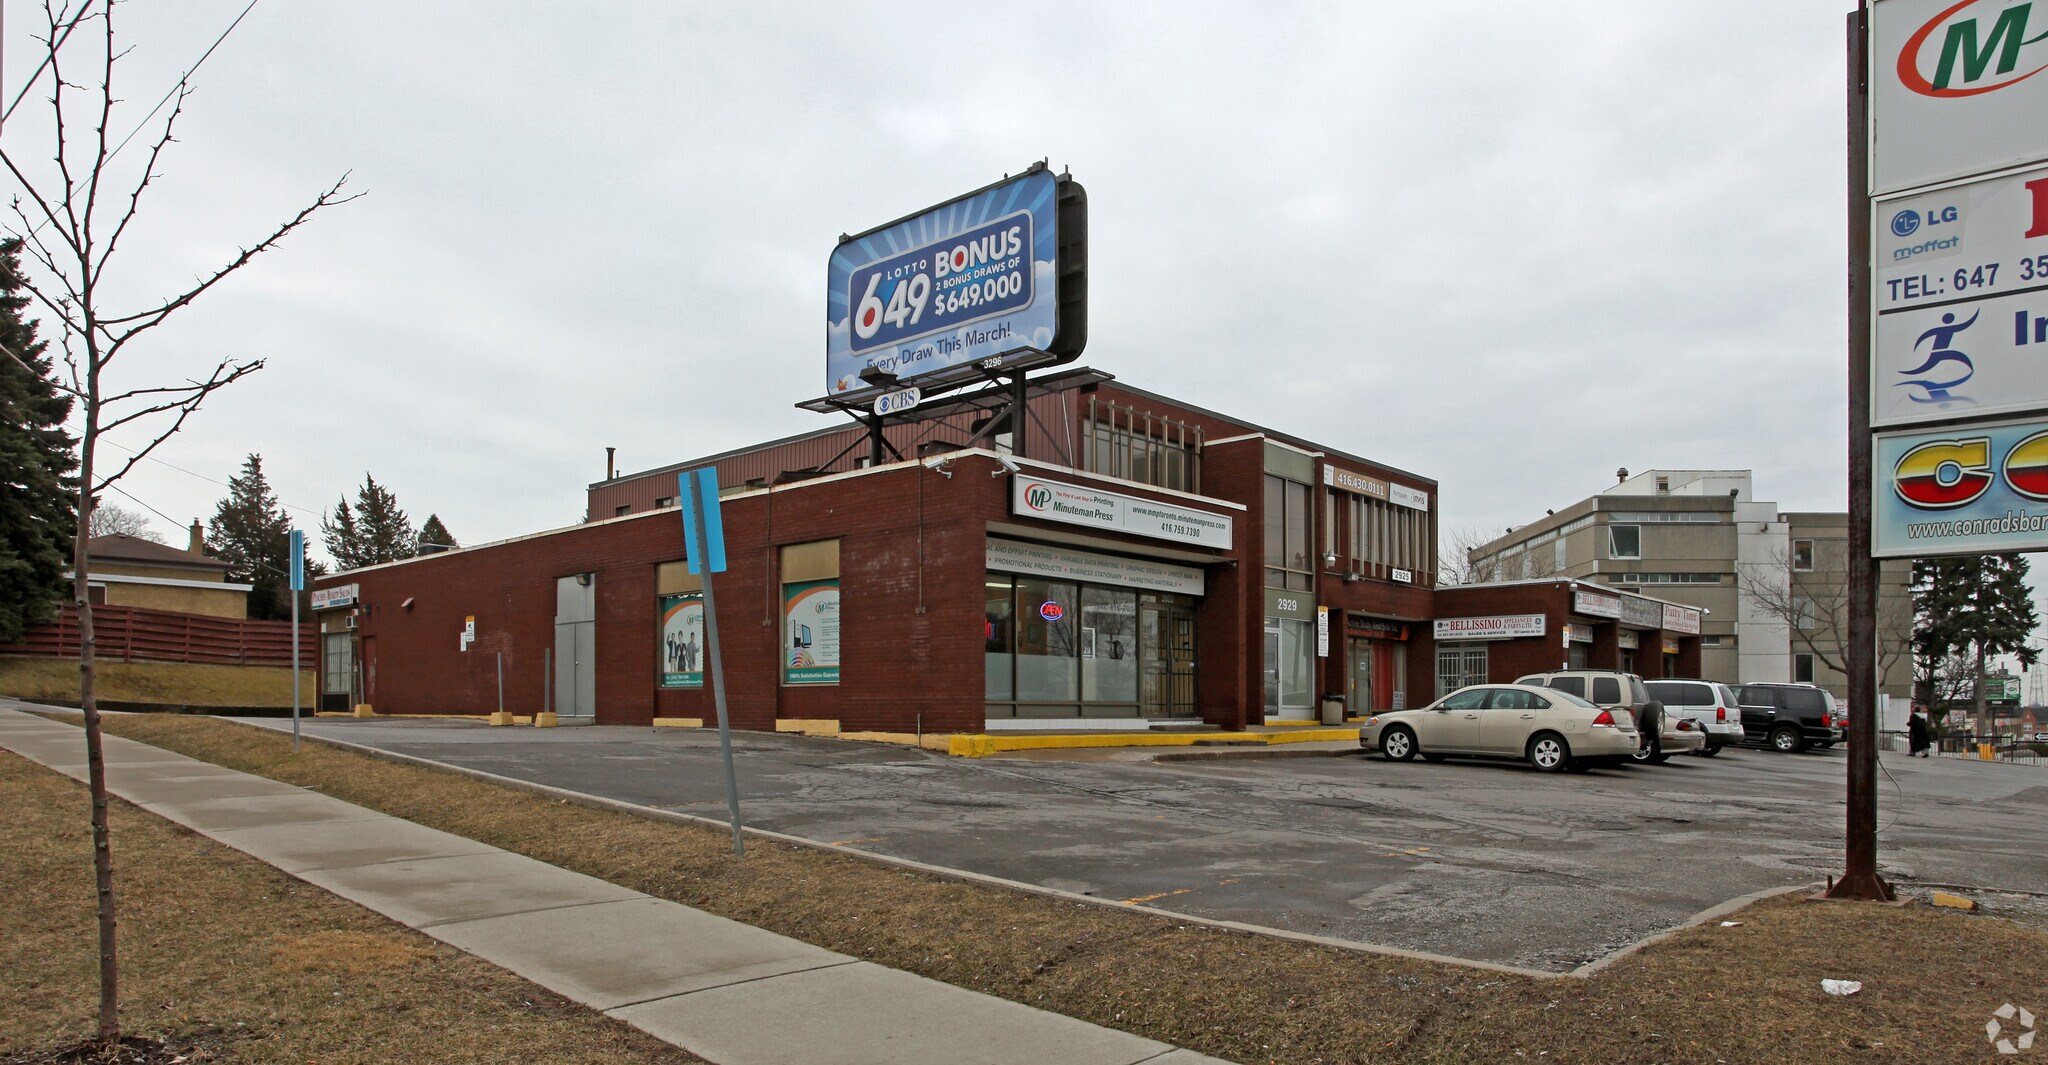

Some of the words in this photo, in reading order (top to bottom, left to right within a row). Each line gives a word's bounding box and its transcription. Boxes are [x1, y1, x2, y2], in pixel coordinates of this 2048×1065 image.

[1928, 206, 1957, 226] LG
[935, 226, 1022, 278] BONUS
[1894, 236, 1959, 259] moffat
[887, 259, 927, 281] LOTTO
[936, 281, 941, 291] 2
[943, 272, 972, 289] BONUS
[973, 263, 1006, 281] DRAWS
[1008, 257, 1020, 269] OF
[1887, 275, 1944, 301] TEL:
[1954, 263, 1999, 291] 647
[934, 271, 1022, 316] $649,000
[854, 272, 932, 339] 649
[866, 356, 898, 372] Every
[902, 344, 933, 364] Draw
[937, 337, 962, 354] This
[965, 321, 1011, 347] March!
[984, 356, 1002, 369] 3296
[891, 390, 915, 410] CBS
[1338, 473, 1384, 496] 416.430.0111
[1053, 501, 1094, 518] Minuteman
[1094, 509, 1114, 522] Press
[1093, 496, 1114, 508] Printing
[1161, 522, 1200, 538] 416.759.7390
[1008, 548, 1028, 556] OFFSET
[1029, 551, 1052, 560] PRINTING
[994, 557, 1032, 569] PROMOTIONAL
[1034, 563, 1062, 572] PRODUCTS
[1069, 568, 1093, 577] BUSINESS
[1394, 570, 1410, 580] 2925
[1042, 604, 1062, 616] OPEN
[1278, 598, 1297, 611] 2929
[1666, 606, 1680, 621] Patty
[1450, 619, 1502, 631] BELLISSIMO
